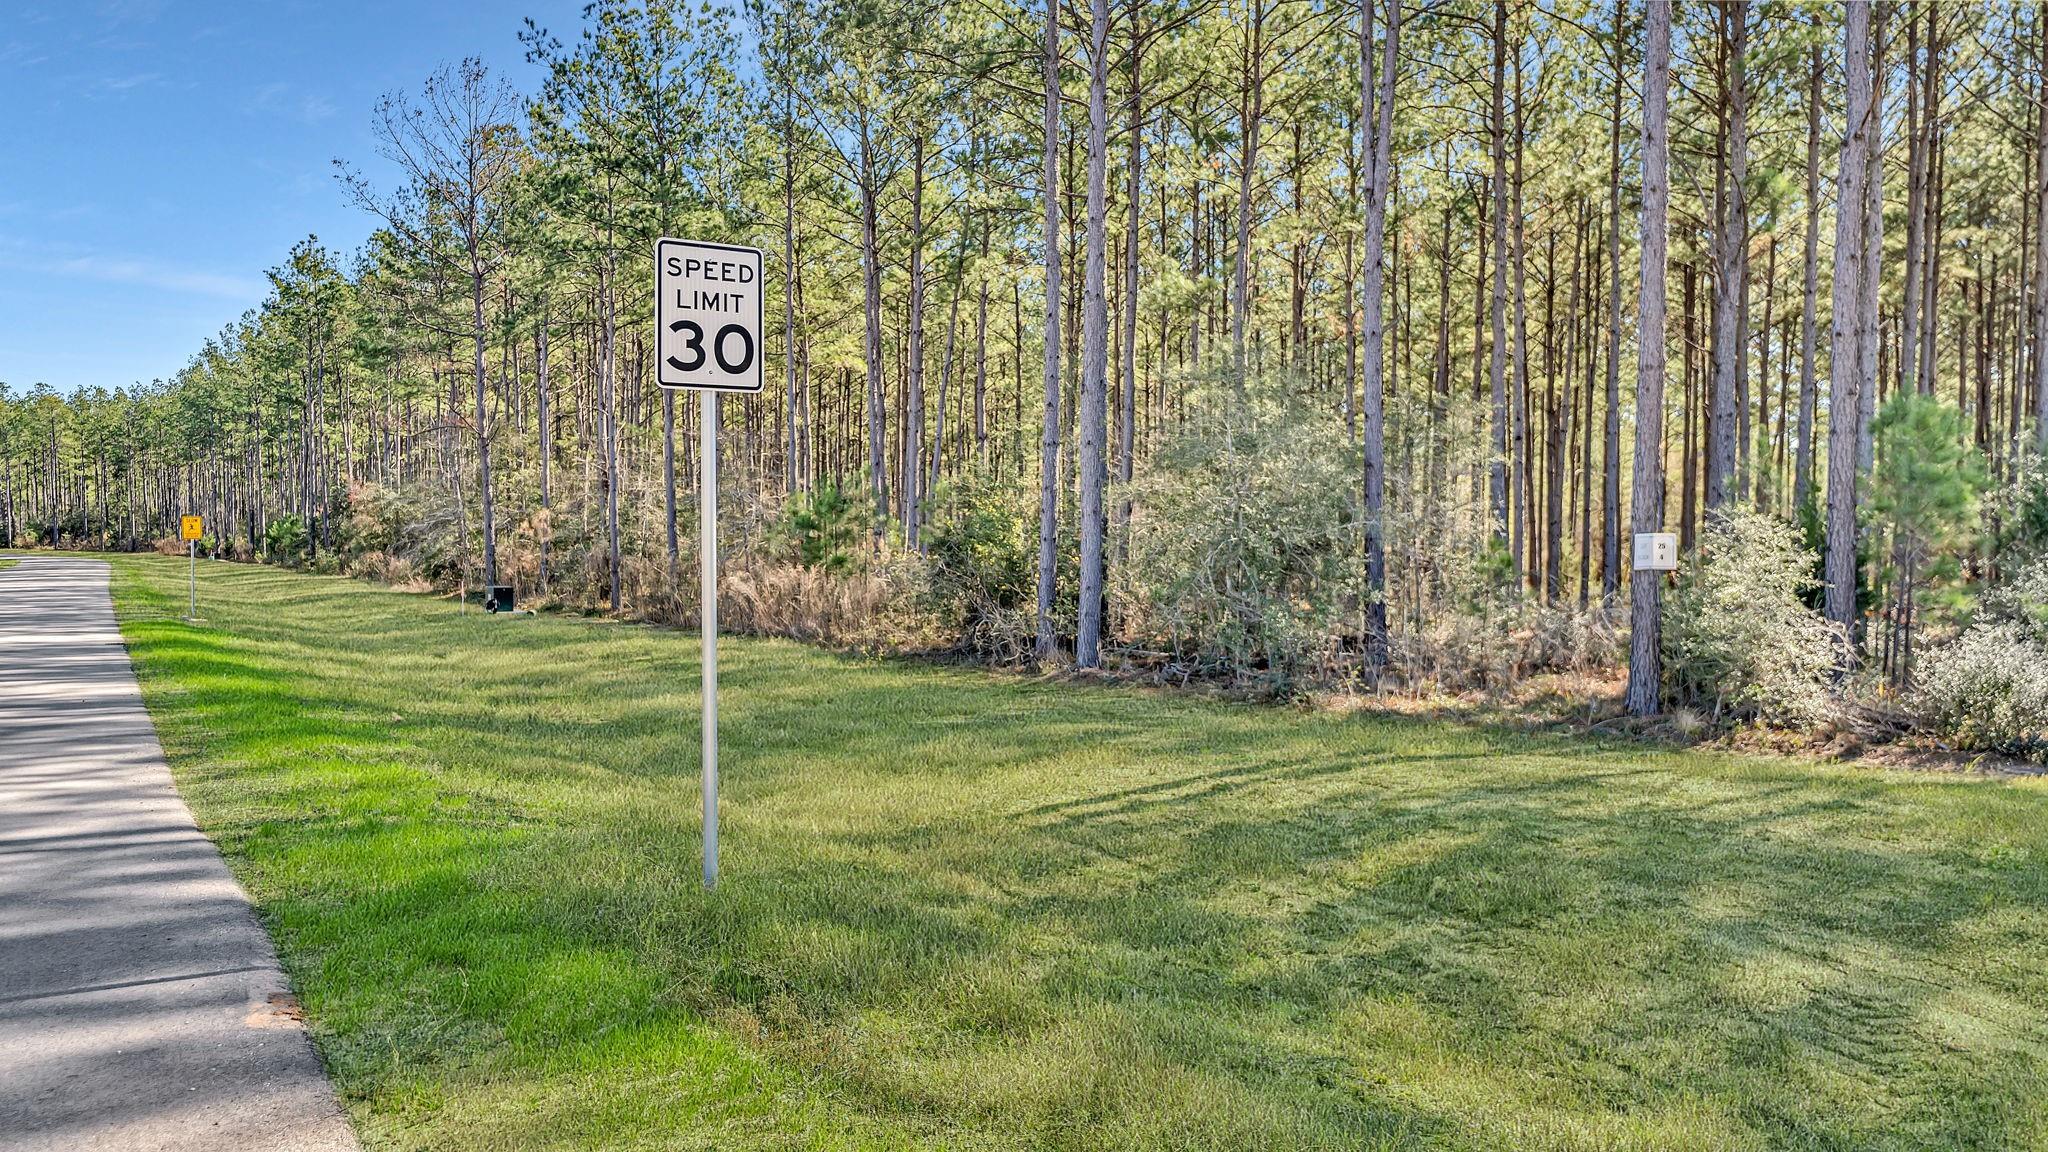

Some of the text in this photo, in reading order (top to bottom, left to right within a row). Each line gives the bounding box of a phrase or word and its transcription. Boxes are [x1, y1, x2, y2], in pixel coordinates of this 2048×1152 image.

[667, 257, 754, 283] SPEED
[676, 289, 744, 313] LIMIT
[666, 320, 754, 374] 30
